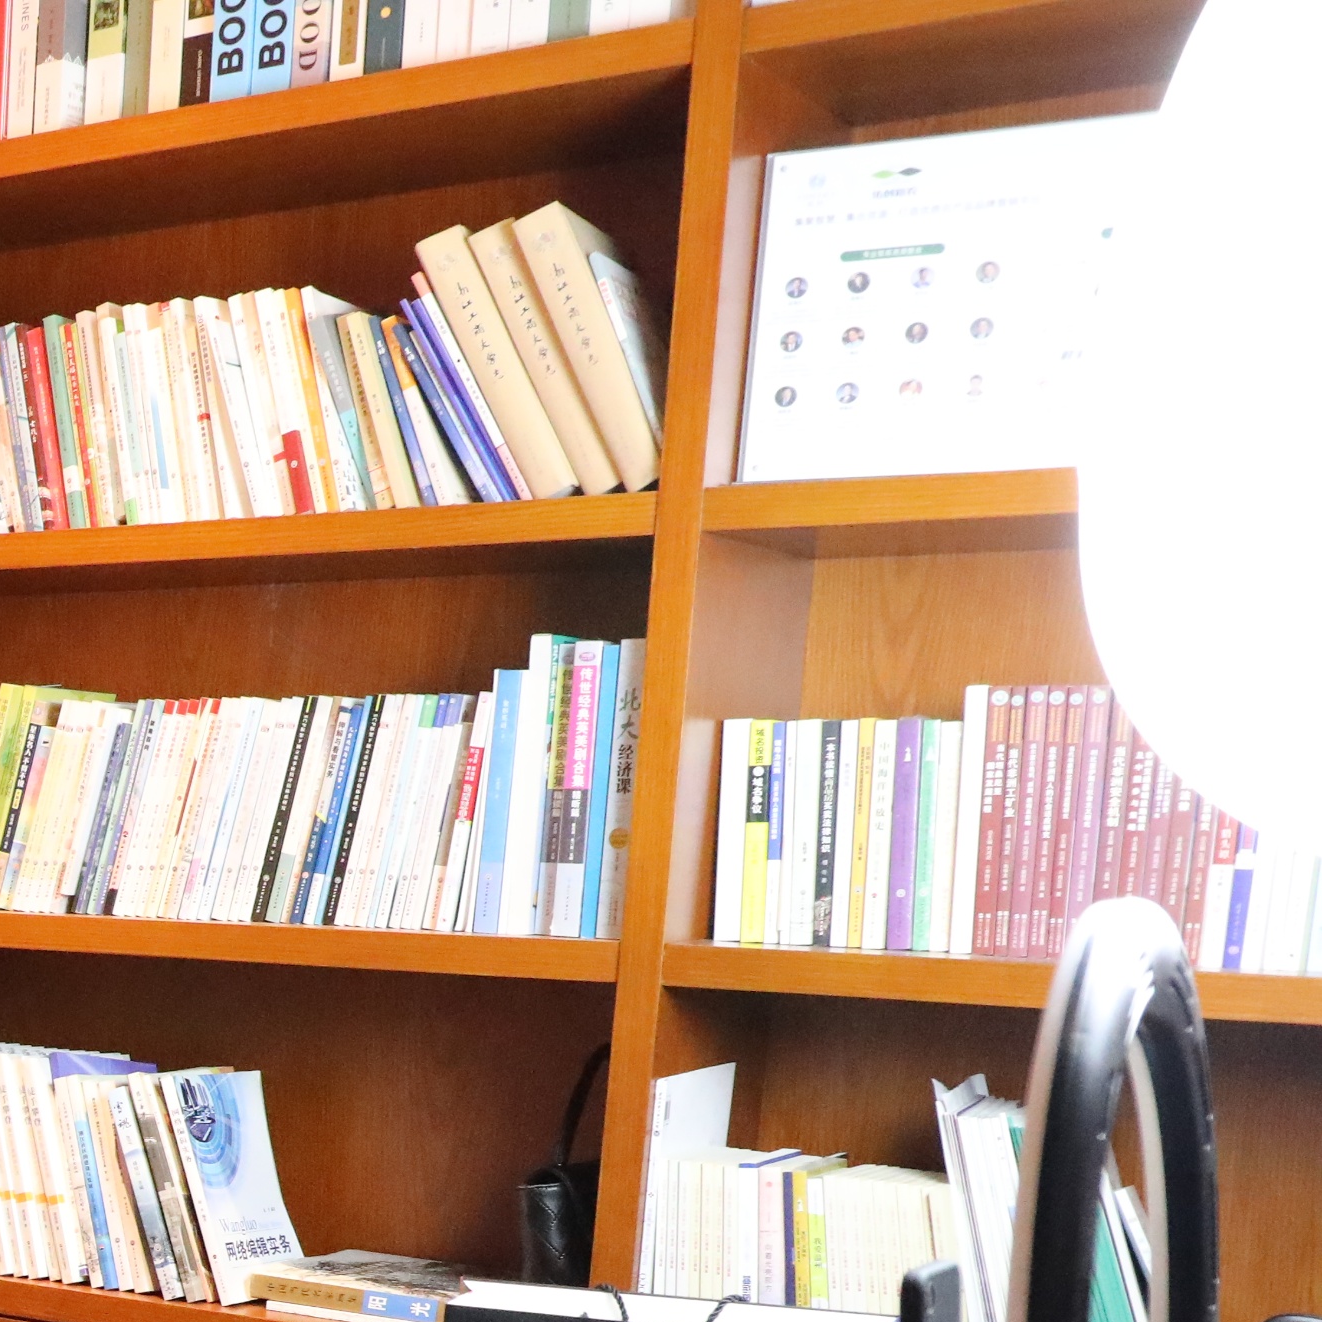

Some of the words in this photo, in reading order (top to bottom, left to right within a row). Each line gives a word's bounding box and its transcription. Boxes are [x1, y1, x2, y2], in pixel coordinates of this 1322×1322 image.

[20, 0, 30, 31] INES
[257, 0, 288, 69] BO
[224, 1233, 293, 1263] 网络编辑实务
